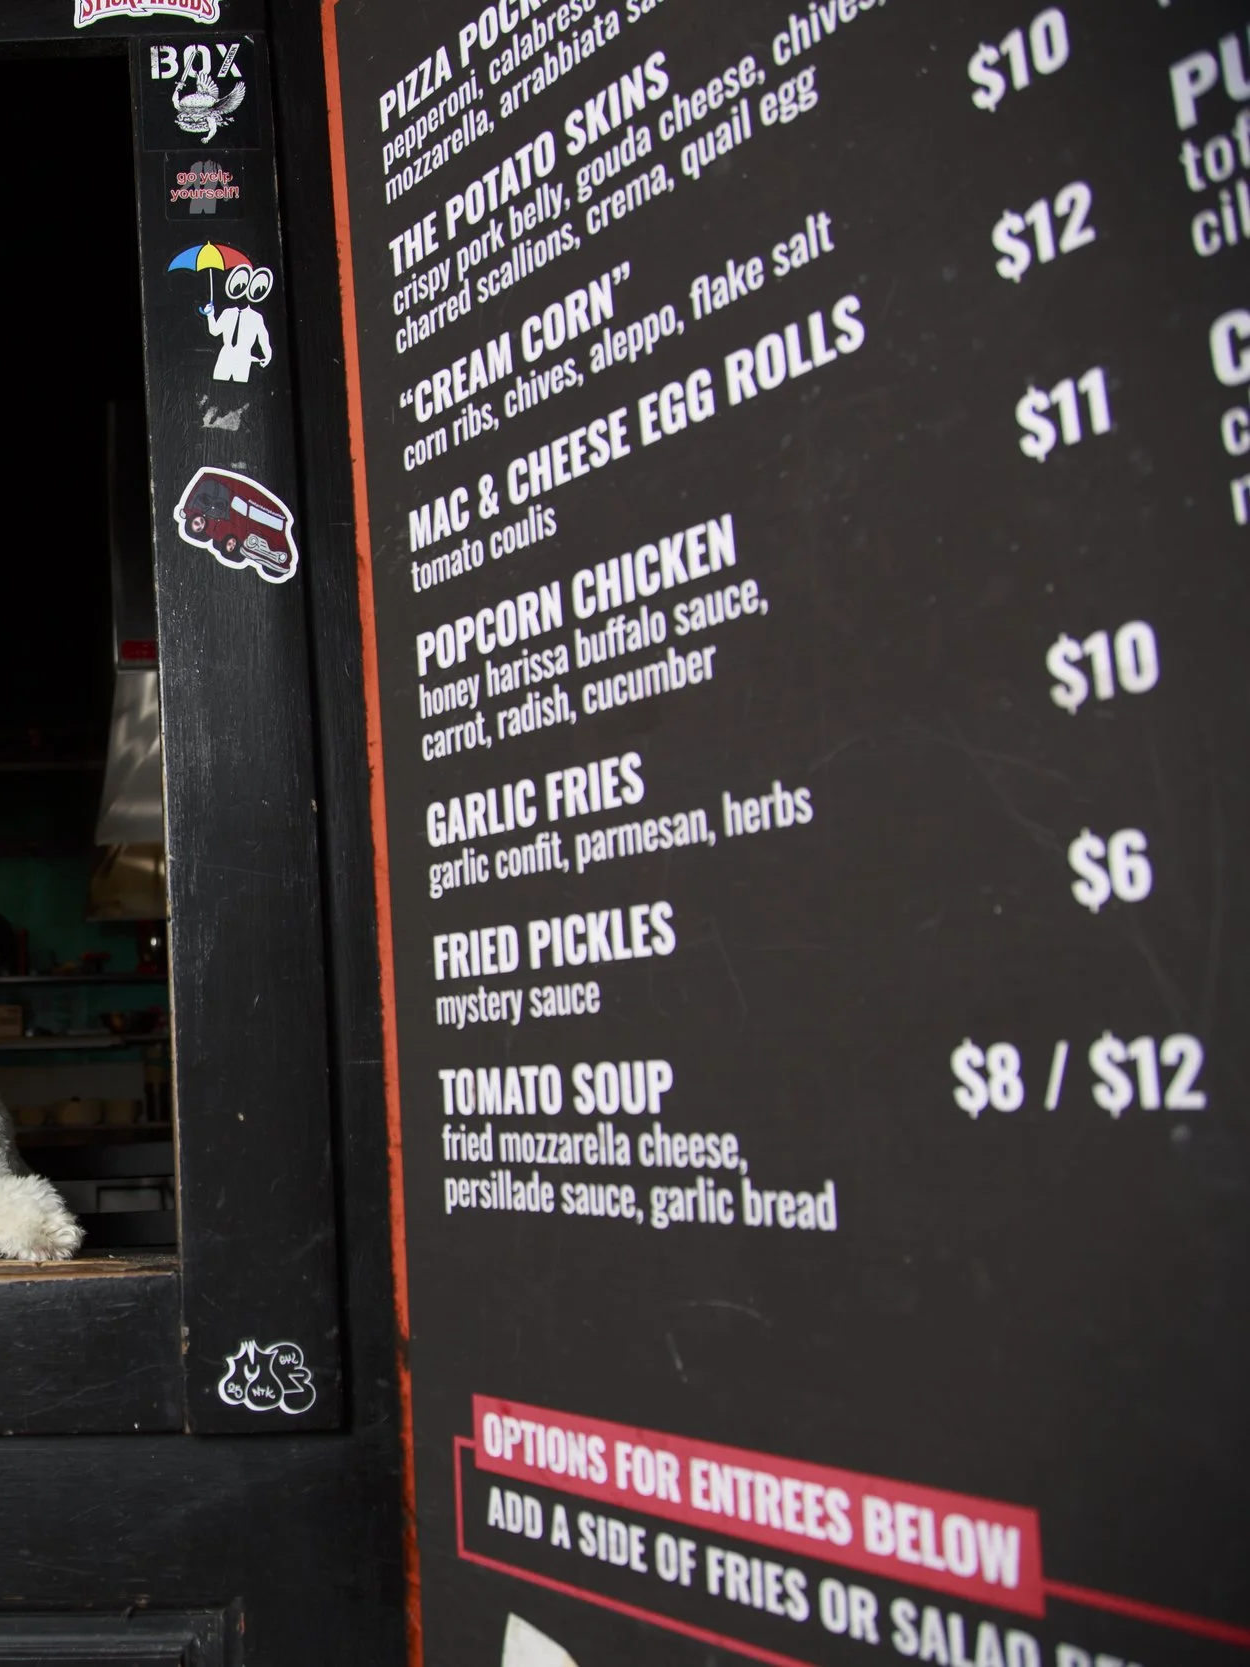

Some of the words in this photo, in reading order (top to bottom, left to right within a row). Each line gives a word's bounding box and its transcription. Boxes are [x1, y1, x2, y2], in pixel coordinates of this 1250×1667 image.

[150, 43, 243, 79] BOX
[220, 46, 238, 75] KITCHEN
[379, 45, 453, 133] PIZZA
[385, 110, 495, 204] mozzarella,
[499, 10, 620, 118] arrabbiata
[968, 6, 1069, 112] $10
[382, 69, 484, 175] pepperoni,
[388, 210, 440, 276] THE
[445, 130, 556, 241] POTATO
[564, 51, 669, 156] SKINS
[170, 185, 240, 202] yourself!
[176, 172, 197, 185] go
[200, 169, 233, 185] yelp
[393, 257, 451, 315] crispy
[456, 218, 506, 281] pork
[508, 182, 571, 241] belly,
[575, 126, 652, 203] gouda
[658, 55, 766, 141] cheese,
[395, 277, 472, 354] charred
[476, 222, 581, 303] scallions,
[586, 163, 675, 234] crema,
[680, 98, 752, 179] quail
[759, 65, 818, 126] egg
[991, 181, 1095, 283] $12
[403, 427, 448, 472] corn
[452, 402, 500, 447] ribs,
[504, 357, 584, 418] chives,
[589, 304, 685, 374] aleppo,
[689, 256, 765, 320] flake
[771, 211, 835, 276] salt
[408, 486, 470, 553] MAC
[477, 473, 500, 520] &
[506, 406, 631, 506] CHEESE
[637, 368, 715, 447] EGG
[724, 295, 865, 406] ROLLS
[1015, 366, 1110, 463] $11
[410, 538, 484, 593] tomato
[489, 503, 557, 559] coulis
[416, 580, 563, 677] POPCORN
[571, 513, 736, 620] CHICKEN
[418, 673, 480, 720] honey
[485, 644, 570, 698] harissa
[574, 605, 667, 669] buffalo
[673, 579, 769, 636] sauce,
[1046, 620, 1159, 714] $10
[421, 711, 493, 761] carrot,
[496, 684, 577, 740] radish,
[582, 645, 717, 715] cucumber
[426, 778, 537, 847] GARLIC
[545, 751, 644, 821] FRIES
[429, 847, 490, 900] garlic
[494, 831, 570, 880] confit,
[574, 808, 716, 874] parmesan,
[722, 780, 814, 837] herbs
[1068, 828, 1152, 913] $6
[433, 924, 519, 981] FRIED
[527, 900, 676, 970] PICKLES
[435, 985, 523, 1030] mystery
[529, 981, 601, 1018] sauce
[438, 1064, 563, 1116] TOMATO
[571, 1060, 673, 1115] SOUP
[950, 1037, 1024, 1119] $8
[1045, 1040, 1068, 1111] /
[1089, 1031, 1206, 1118] $12
[441, 1121, 493, 1162] fried
[499, 1121, 631, 1165] mozzarella
[637, 1121, 748, 1175] cheese,
[444, 1169, 555, 1215] persillade
[560, 1182, 644, 1225] sauce,
[650, 1175, 735, 1230] garlic
[741, 1177, 837, 1231] bread
[482, 1411, 607, 1485] OPTIONS
[614, 1440, 682, 1504] FOR
[689, 1457, 853, 1546] ENTREES
[861, 1495, 1020, 1588] BELOW
[487, 1486, 542, 1539] ADD
[550, 1504, 571, 1550] A
[577, 1510, 648, 1572] SIDE
[655, 1533, 696, 1586] OF
[706, 1546, 809, 1621] FRIES
[819, 1578, 879, 1643] OR
[890, 1598, 1039, 1667] SALAD
